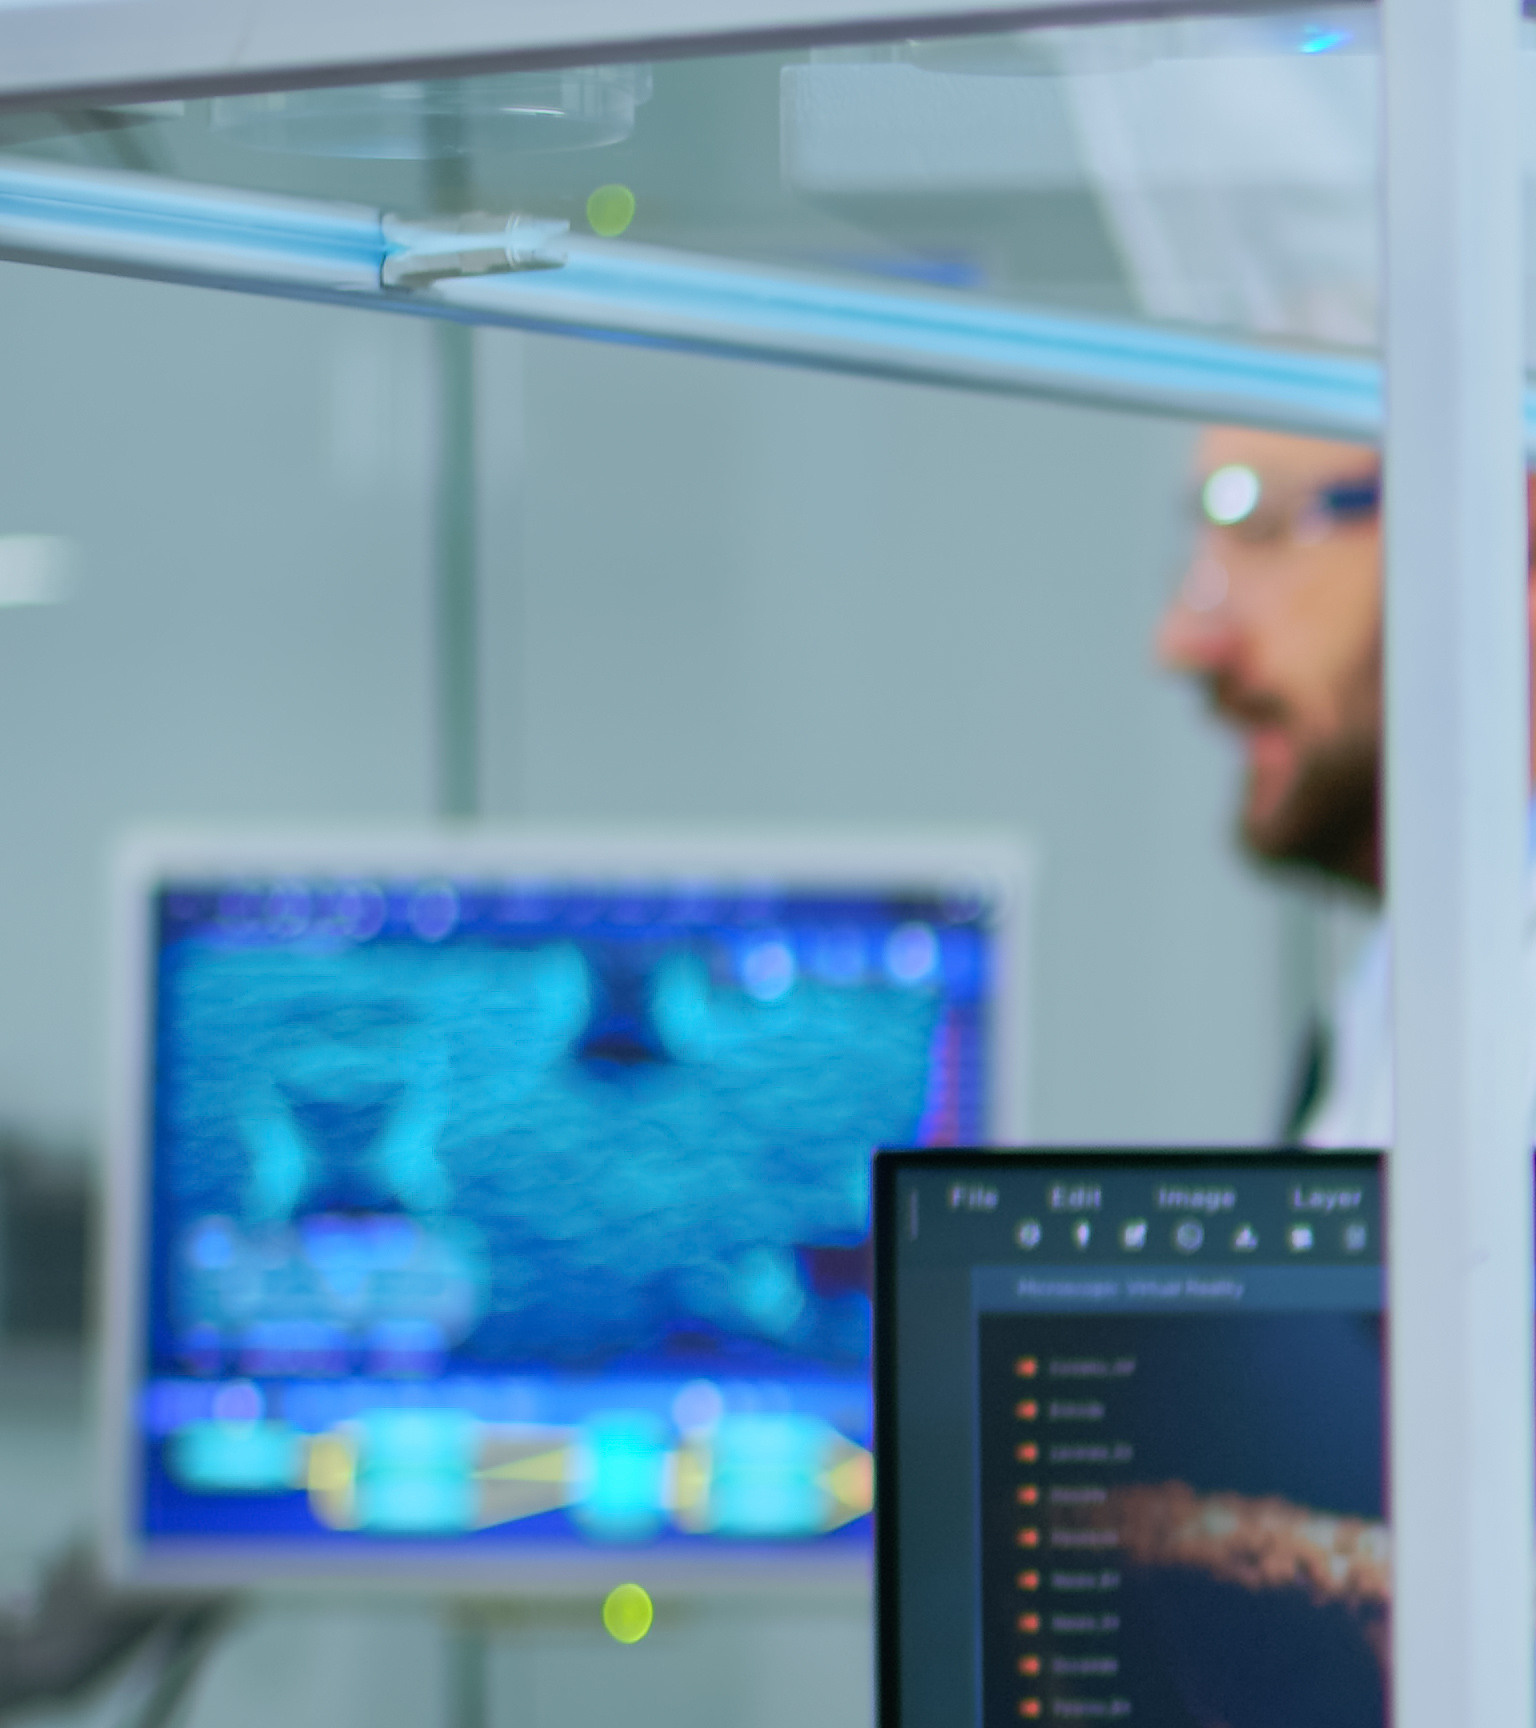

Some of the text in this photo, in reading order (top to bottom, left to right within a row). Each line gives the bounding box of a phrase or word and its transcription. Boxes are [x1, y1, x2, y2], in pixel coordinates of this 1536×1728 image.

[950, 1185, 999, 1209] File
[1050, 1185, 1102, 1209] Edit
[1157, 1186, 1237, 1213] Image
[1292, 1187, 1362, 1213] Layer
[1126, 1278, 1182, 1298] Virtual
